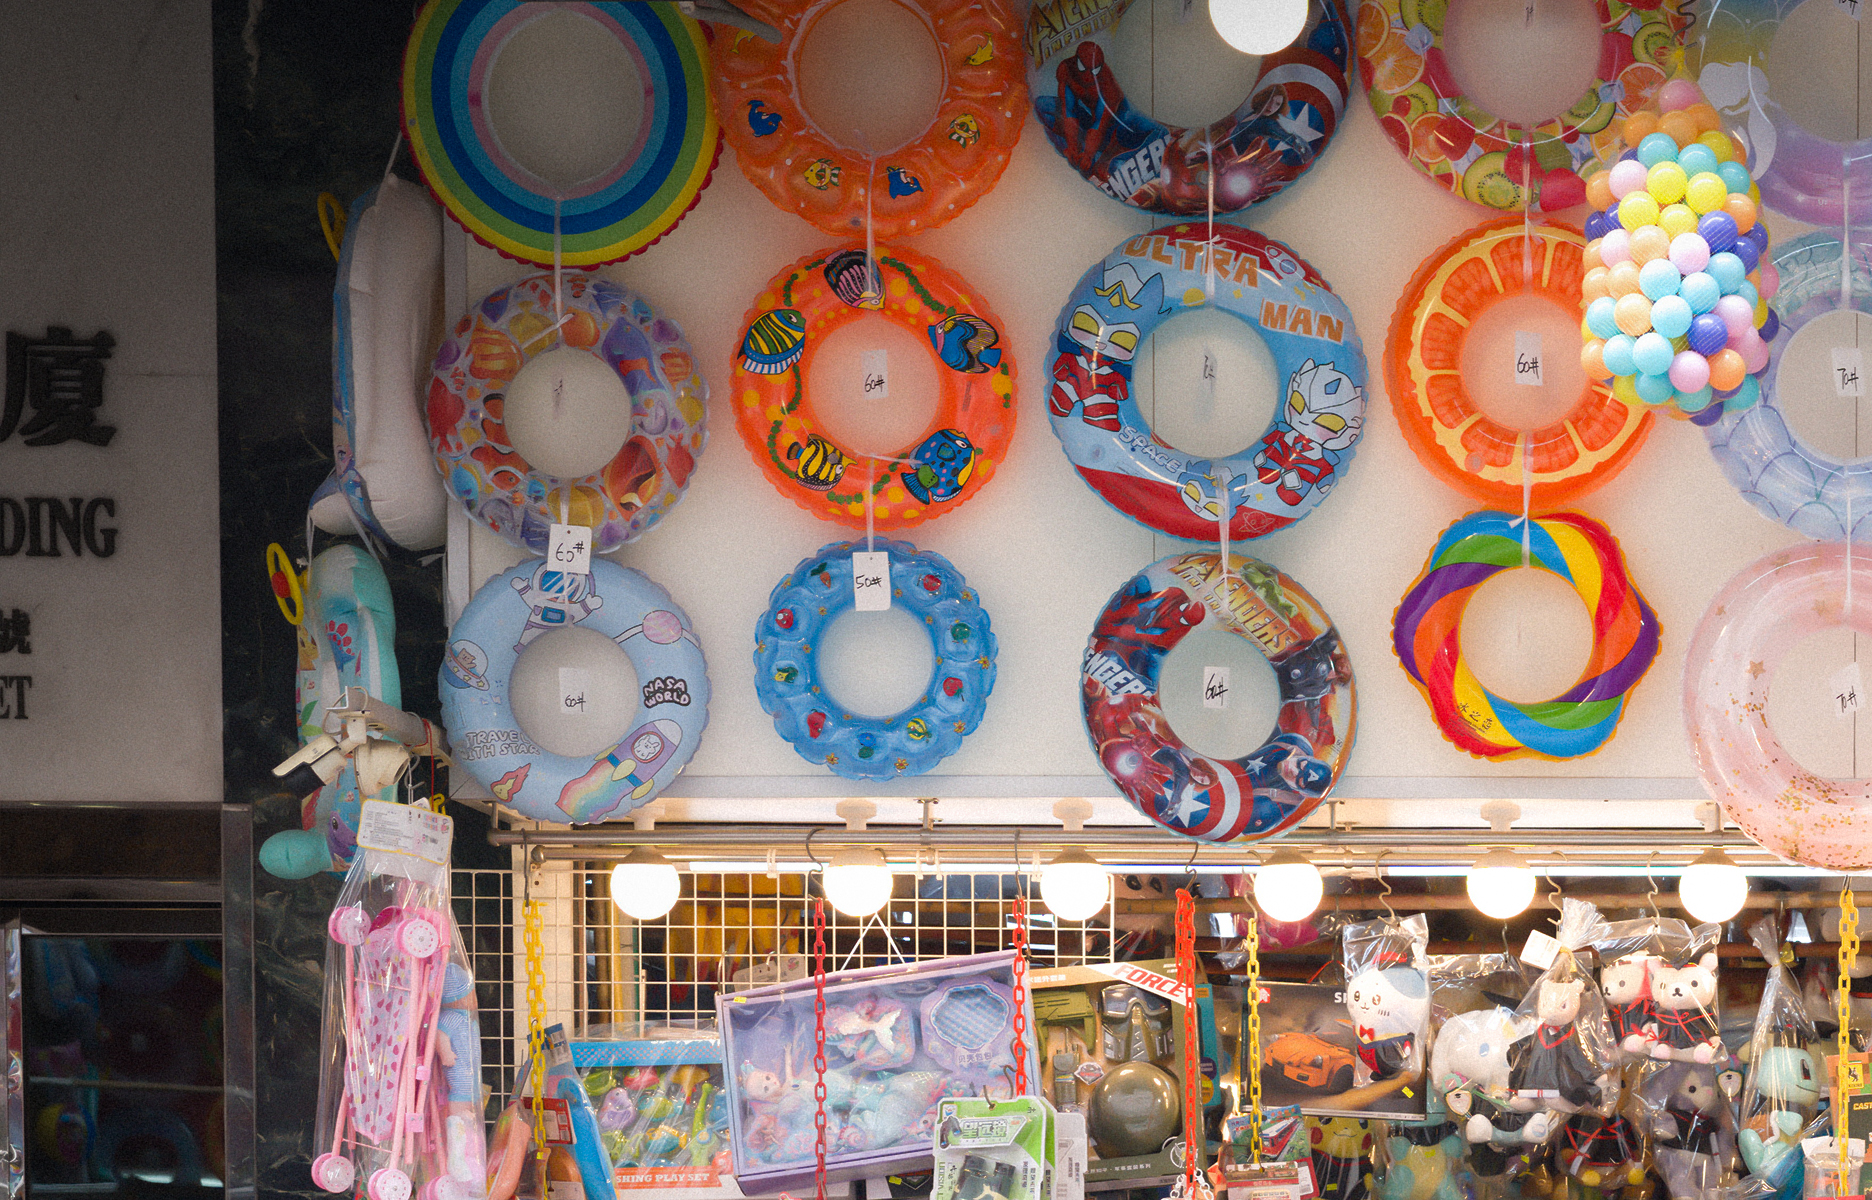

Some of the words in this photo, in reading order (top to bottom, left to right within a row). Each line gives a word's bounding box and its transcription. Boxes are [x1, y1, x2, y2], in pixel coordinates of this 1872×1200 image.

[1122, 235, 1260, 288] ULTRA
[1260, 298, 1344, 344] MAN
[0, 326, 117, 447] 廈
[1118, 426, 1182, 473] SPACE
[644, 677, 687, 697] NASA
[644, 691, 691, 708] WORLD
[1112, 964, 1187, 998] FORCE
[655, 1173, 685, 1183] PLAY
[688, 1172, 709, 1182] SET
